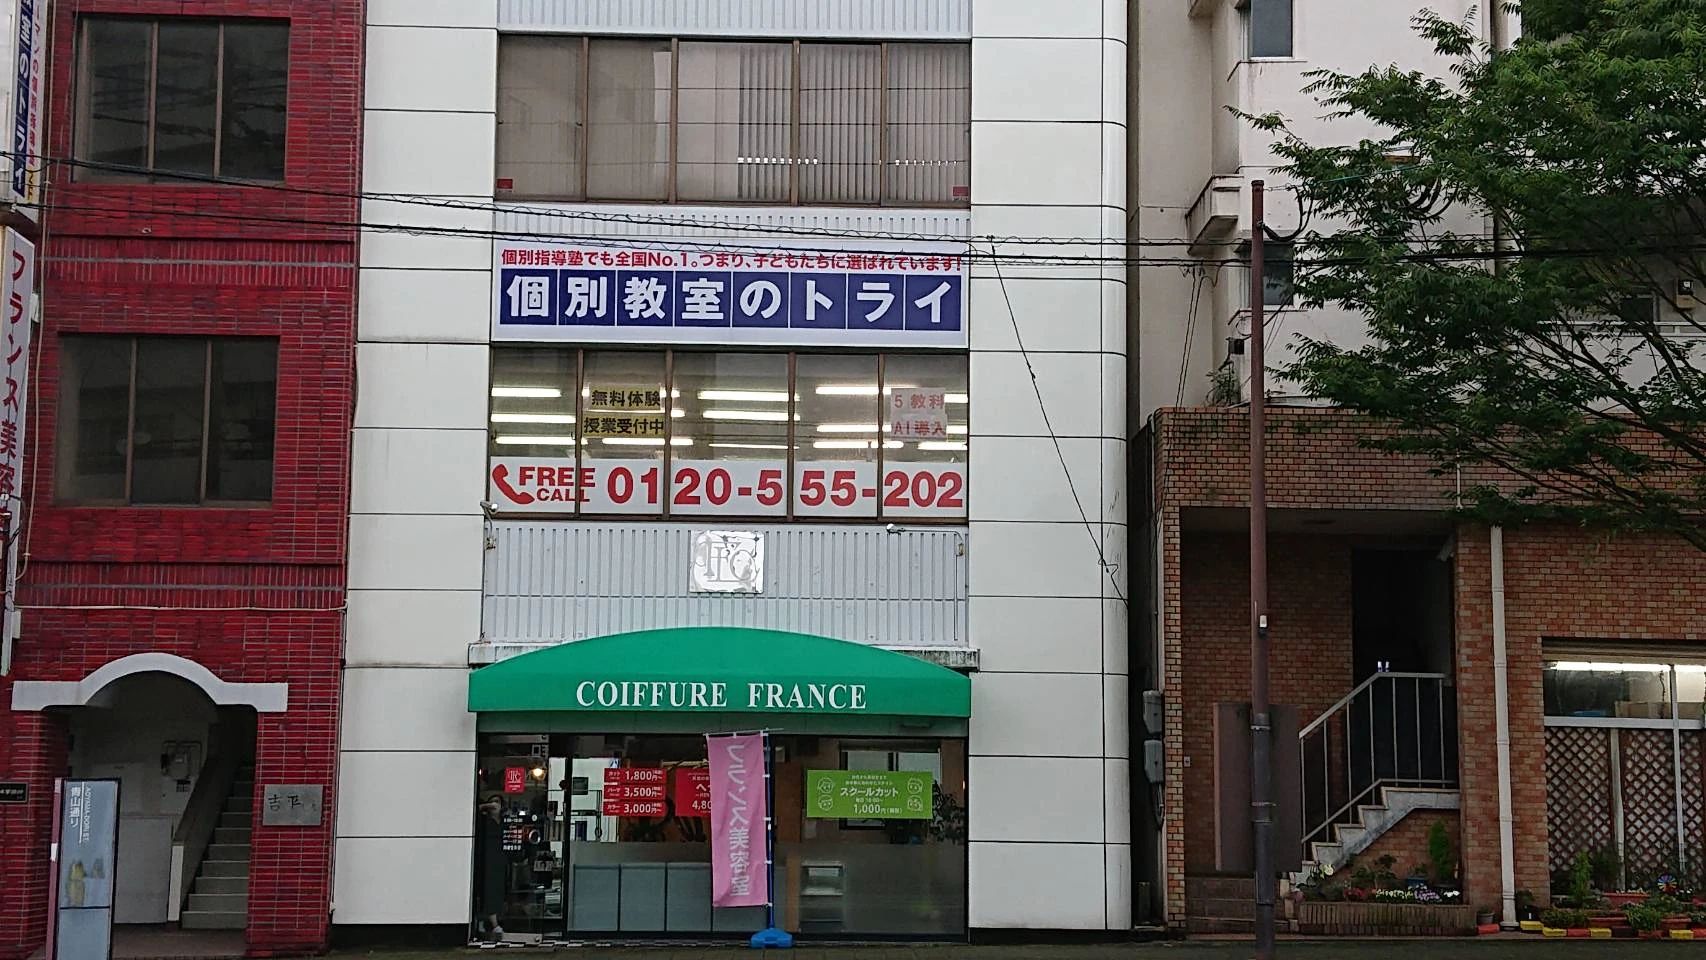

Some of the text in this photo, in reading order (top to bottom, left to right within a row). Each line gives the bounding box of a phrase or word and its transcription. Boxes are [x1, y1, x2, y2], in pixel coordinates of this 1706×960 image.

[15, 0, 33, 190] 室のトライ
[506, 275, 951, 323] 個別教室のトライ
[591, 390, 661, 407] 無料体験
[584, 416, 665, 435] 授業受付中
[519, 466, 596, 488] FREE
[607, 466, 963, 508] 0120-555-202
[536, 488, 590, 503] CALL
[576, 681, 867, 709] COIFFURE FRANCE
[840, 787, 899, 797] スクールカット
[69, 787, 82, 828] 青山通り
